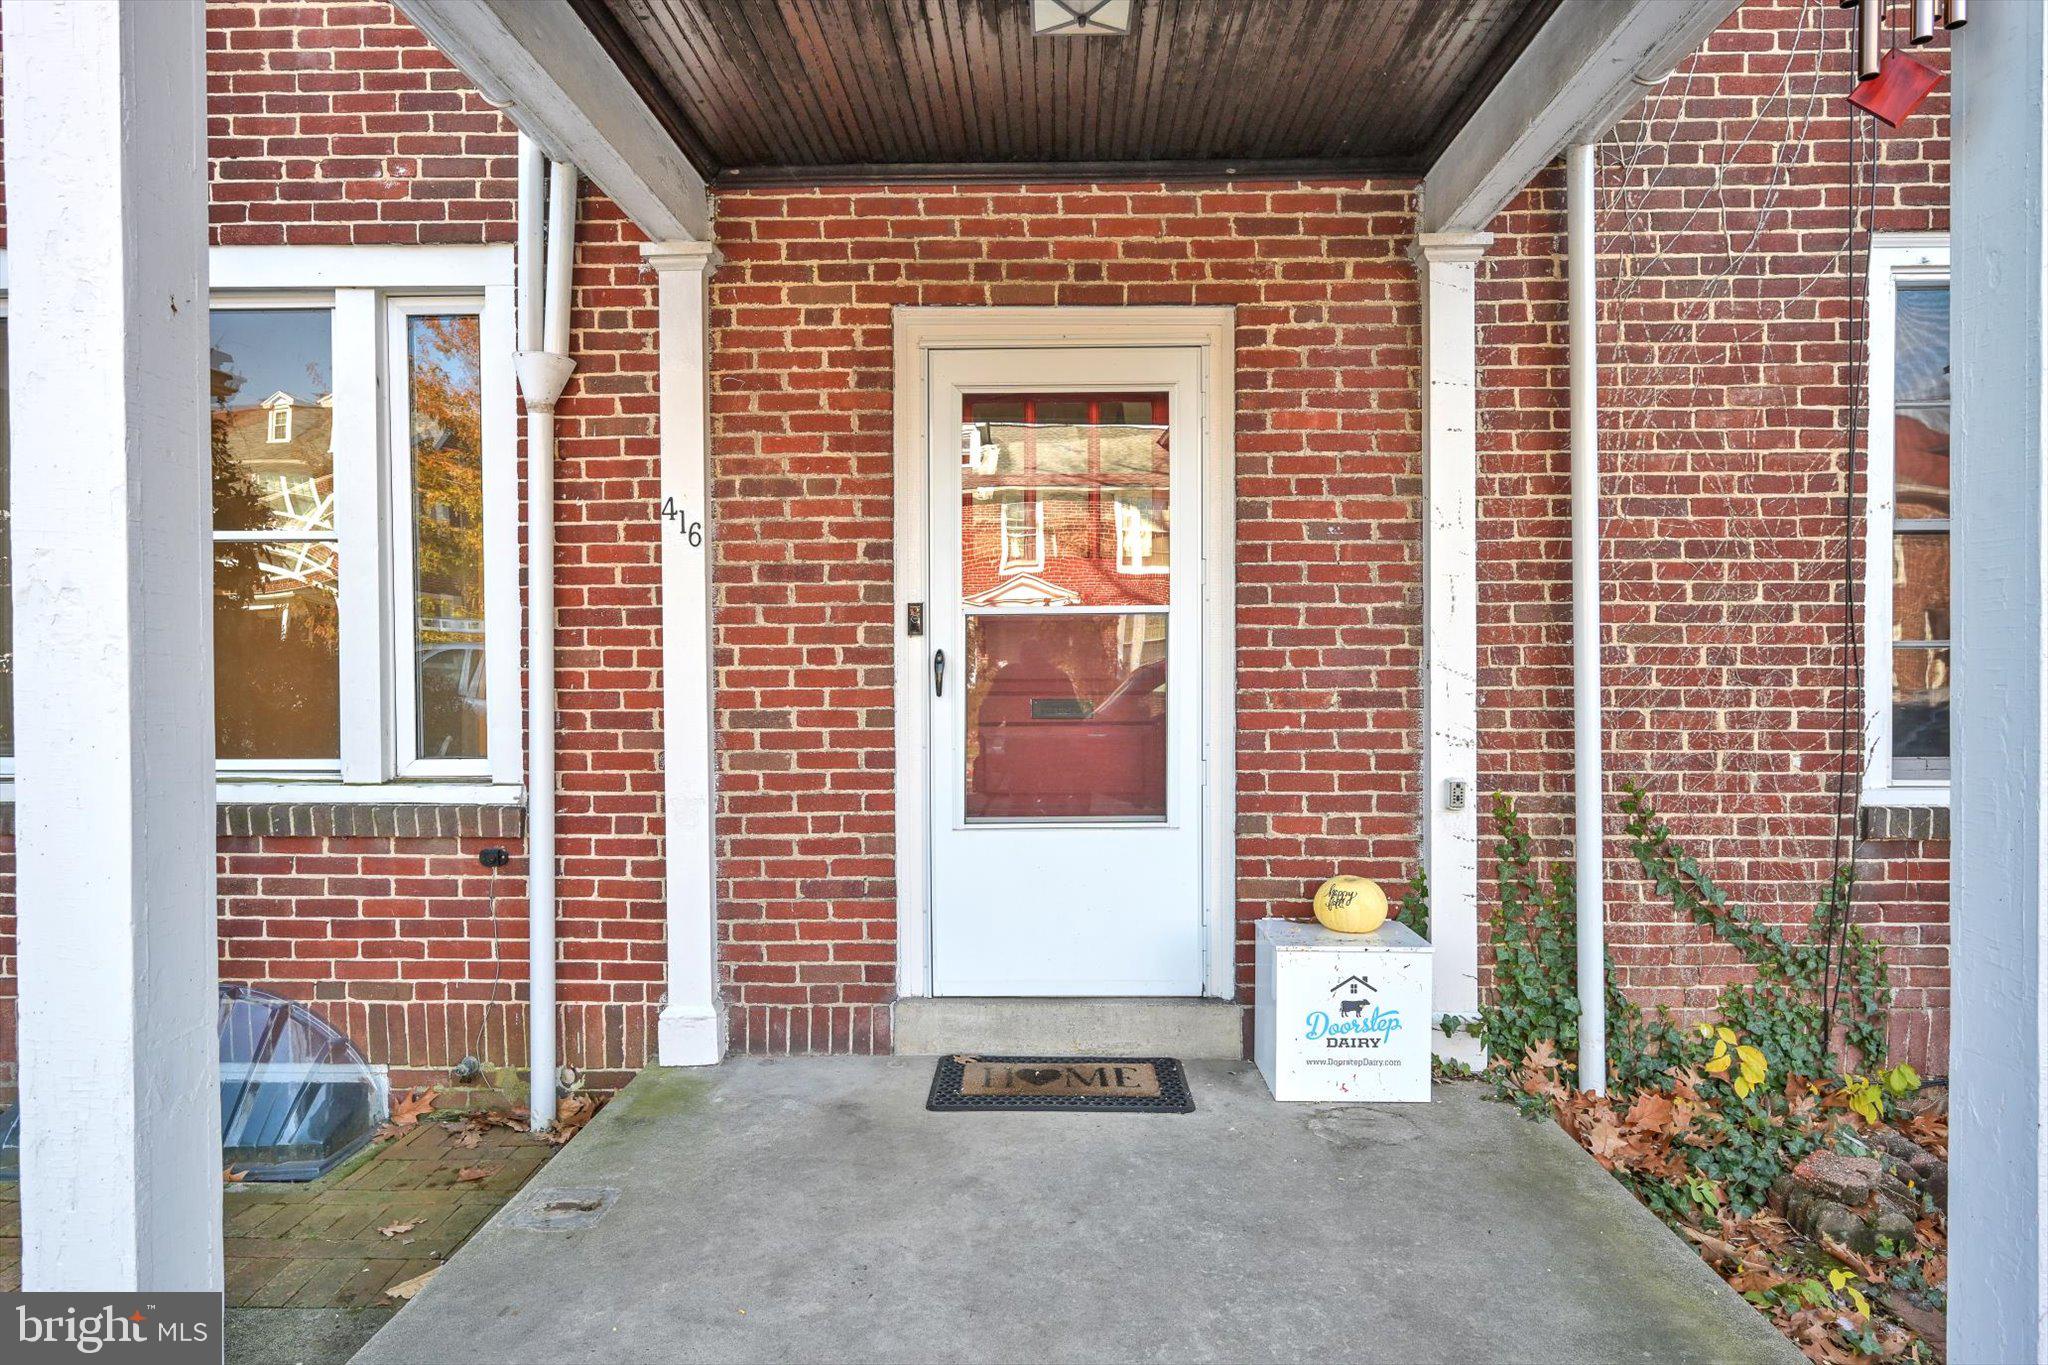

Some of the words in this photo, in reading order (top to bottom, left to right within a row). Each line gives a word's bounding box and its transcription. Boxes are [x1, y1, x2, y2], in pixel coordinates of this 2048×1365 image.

[662, 496, 702, 547] 416
[1305, 1006, 1402, 1044] Doorstep
[1326, 1037, 1381, 1048] DAIRY
[1306, 1058, 1402, 1067] www.DoorstepDairy.com
